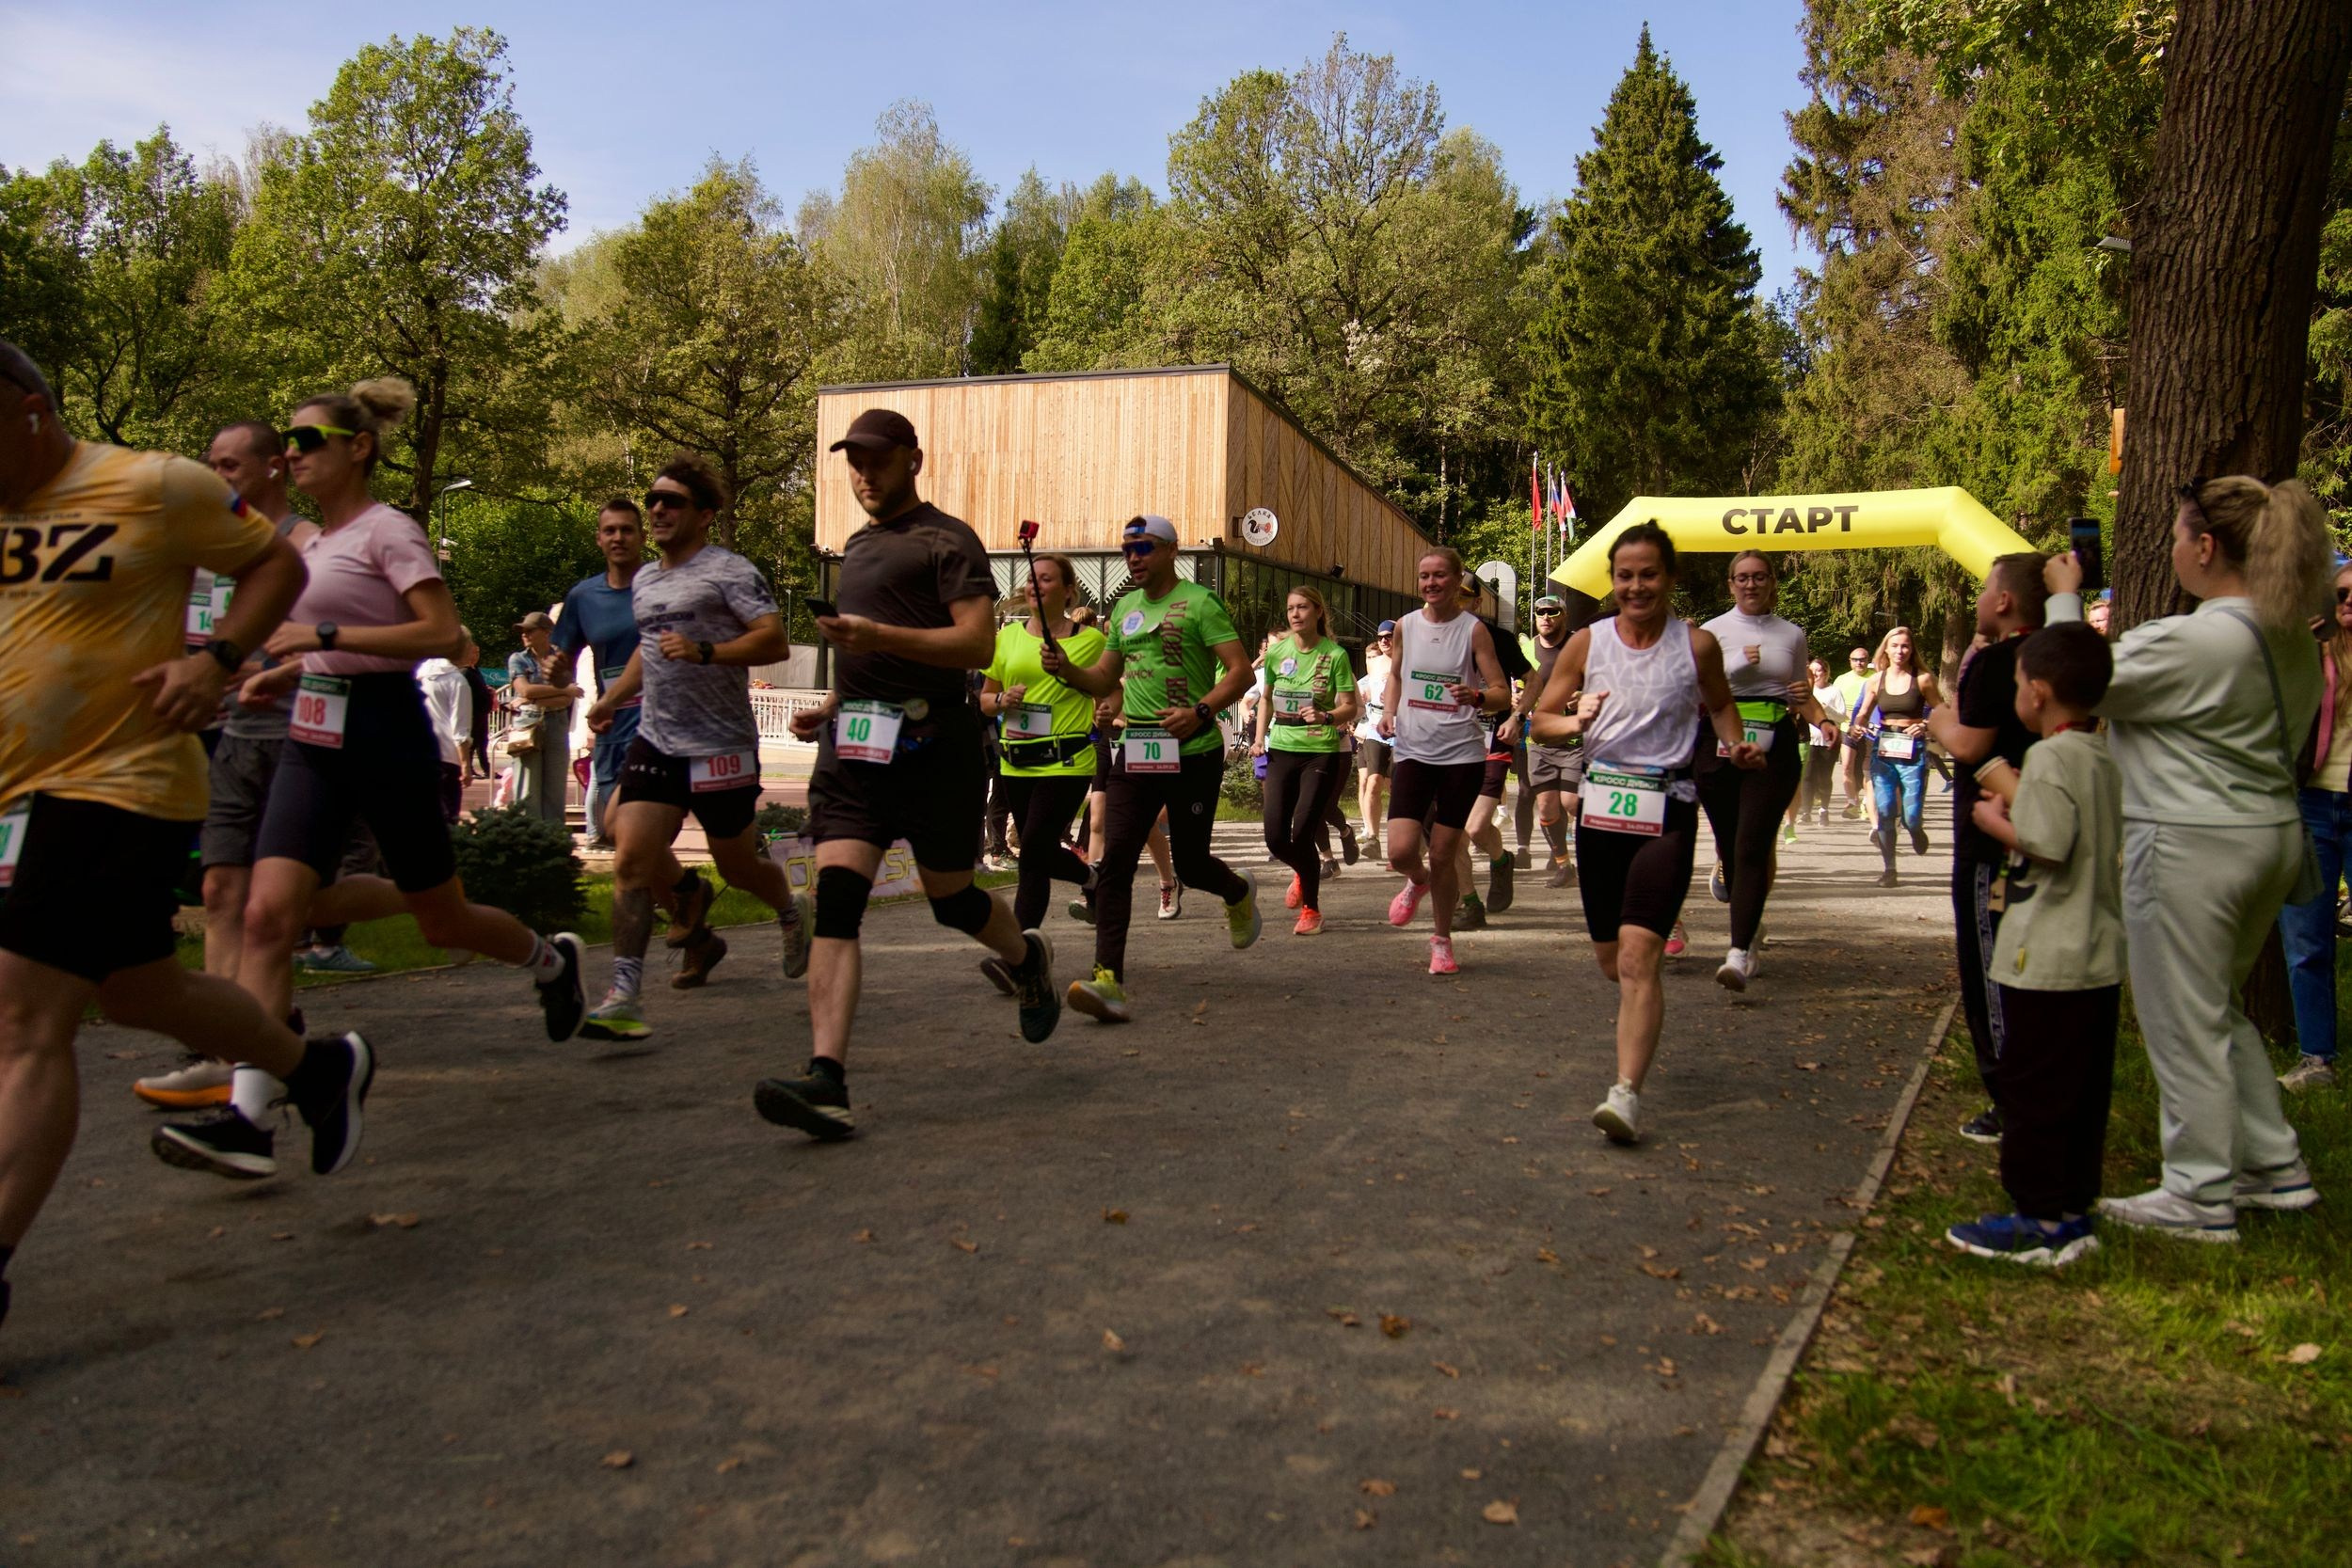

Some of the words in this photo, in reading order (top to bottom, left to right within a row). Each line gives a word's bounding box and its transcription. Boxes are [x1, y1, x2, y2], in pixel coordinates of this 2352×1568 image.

[1248, 510, 1271, 520] БЕЛКА
[1723, 505, 1859, 535] СТАРТ
[1424, 684, 1444, 701] 62
[1286, 700, 1298, 712] 27
[847, 717, 871, 742] 40
[1020, 714, 1029, 731] 3
[1143, 741, 1161, 760] 70
[707, 754, 741, 777] 109
[1594, 774, 1627, 786] КРОСС
[1608, 791, 1638, 817] 28
